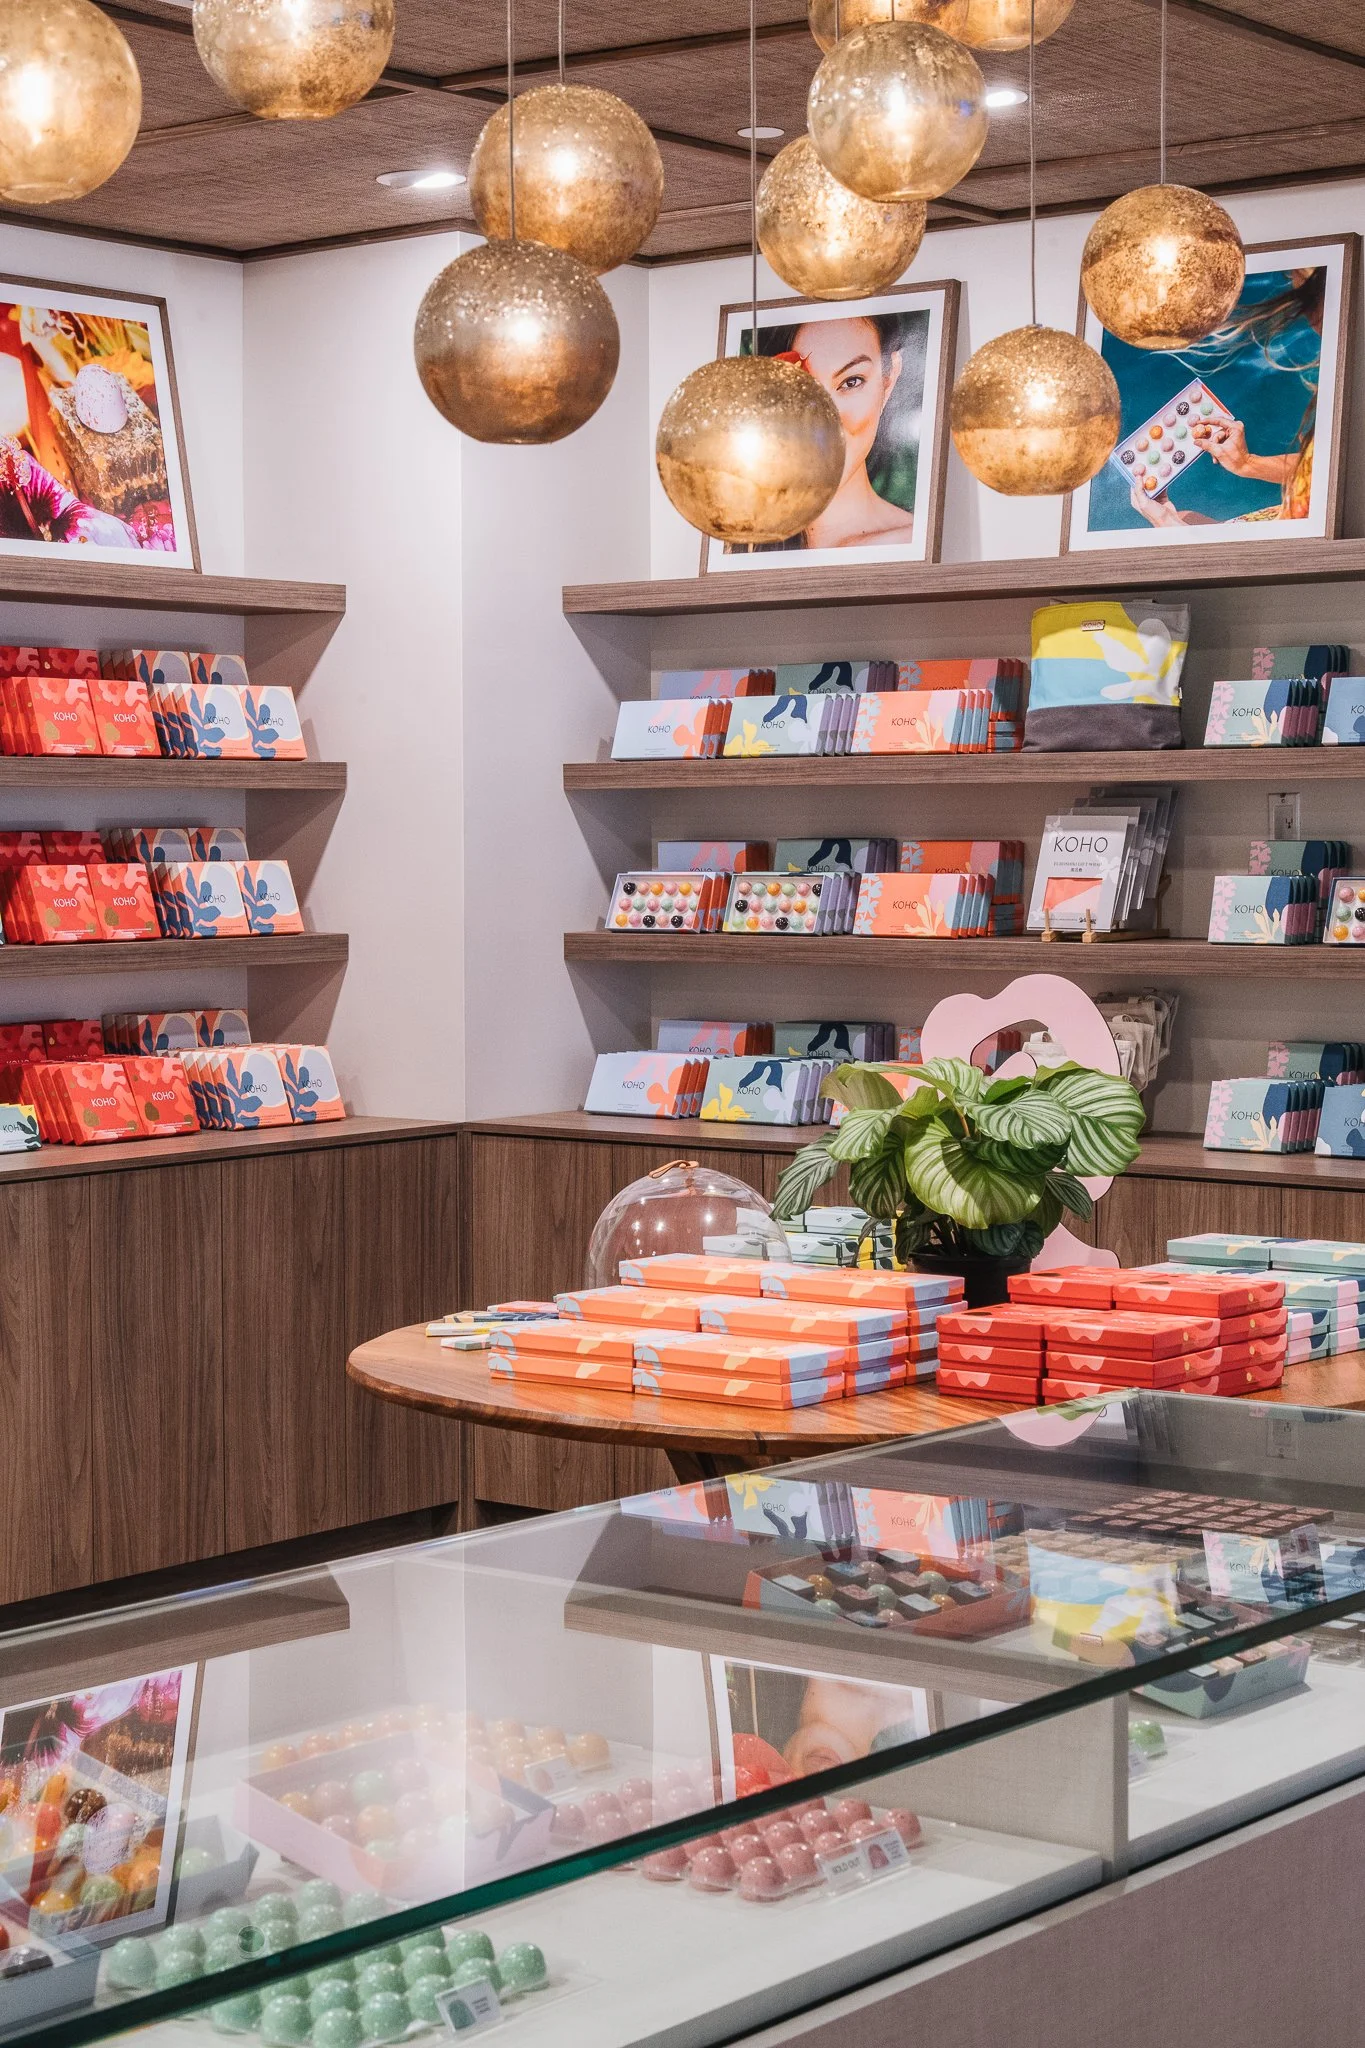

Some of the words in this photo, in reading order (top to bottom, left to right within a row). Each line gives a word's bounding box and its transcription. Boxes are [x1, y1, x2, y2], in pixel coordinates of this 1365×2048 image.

[53, 711, 78, 722] KOHO
[1231, 707, 1262, 717] KOHO
[113, 712, 137, 723] KOHO
[206, 715, 231, 725] KOHO
[260, 716, 284, 727] KOHO
[891, 717, 917, 726] KOHO
[760, 719, 786, 729] KOHO
[647, 725, 671, 734] KOHO
[1053, 836, 1108, 853] KOHO
[806, 866, 831, 874] KOHO
[112, 897, 137, 907] KOHO
[202, 895, 227, 904] KOHO
[259, 893, 281, 902] KOHO
[53, 898, 77, 908] KOHO
[892, 900, 918, 909] KOHO
[1234, 904, 1264, 914] KOHO
[1289, 1070, 1319, 1079] KOHO
[243, 1083, 268, 1094] KOHO
[302, 1078, 323, 1089] KOHO
[621, 1080, 646, 1090] KOHO
[151, 1091, 175, 1101] KOHO
[736, 1086, 761, 1096] KOHO
[91, 1097, 117, 1108] KOHO
[1231, 1110, 1261, 1121] KOHO
